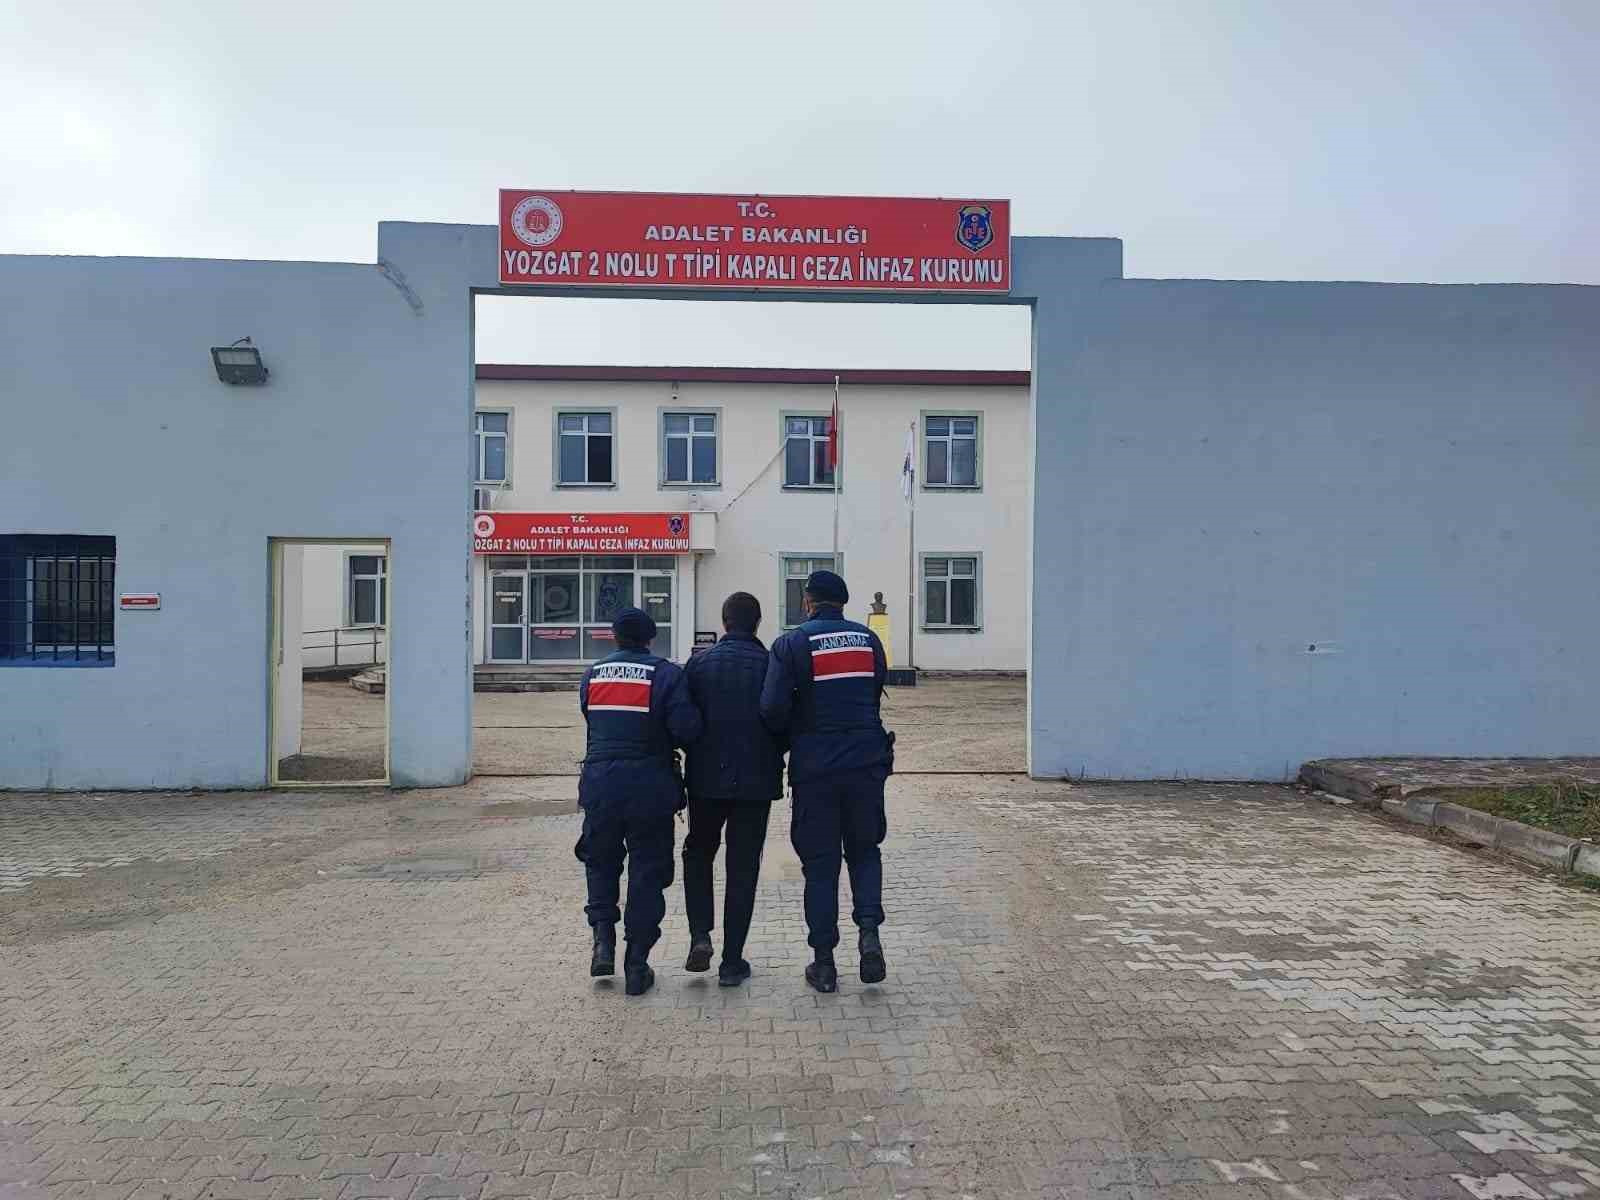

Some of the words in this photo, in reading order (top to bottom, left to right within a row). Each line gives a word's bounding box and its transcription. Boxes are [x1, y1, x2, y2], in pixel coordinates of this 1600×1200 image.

[737, 202, 776, 218] T.C.
[645, 226, 734, 242] ADALET
[742, 225, 867, 244] BAKANLIĞI
[504, 250, 583, 276] YOZGAT
[588, 251, 600, 276] 2
[606, 252, 659, 278] NOLU
[665, 254, 677, 278] T
[683, 248, 720, 279] TİPİ
[728, 254, 796, 280] KAPALI
[803, 255, 853, 281] CEZA
[859, 251, 914, 282] İNFAZ
[920, 258, 1003, 283] KURUMU
[570, 515, 589, 523] T.C.
[530, 526, 570, 534] ADALET
[475, 538, 504, 550] OZGAT
[506, 538, 512, 550] 2
[513, 538, 537, 550] NOLU
[539, 539, 545, 550] T
[566, 538, 598, 550] KAPALI
[599, 538, 623, 550] CEZA
[651, 538, 689, 550] KURUMU
[818, 634, 868, 650] JANDARMA
[596, 665, 648, 681] JANDARMA
